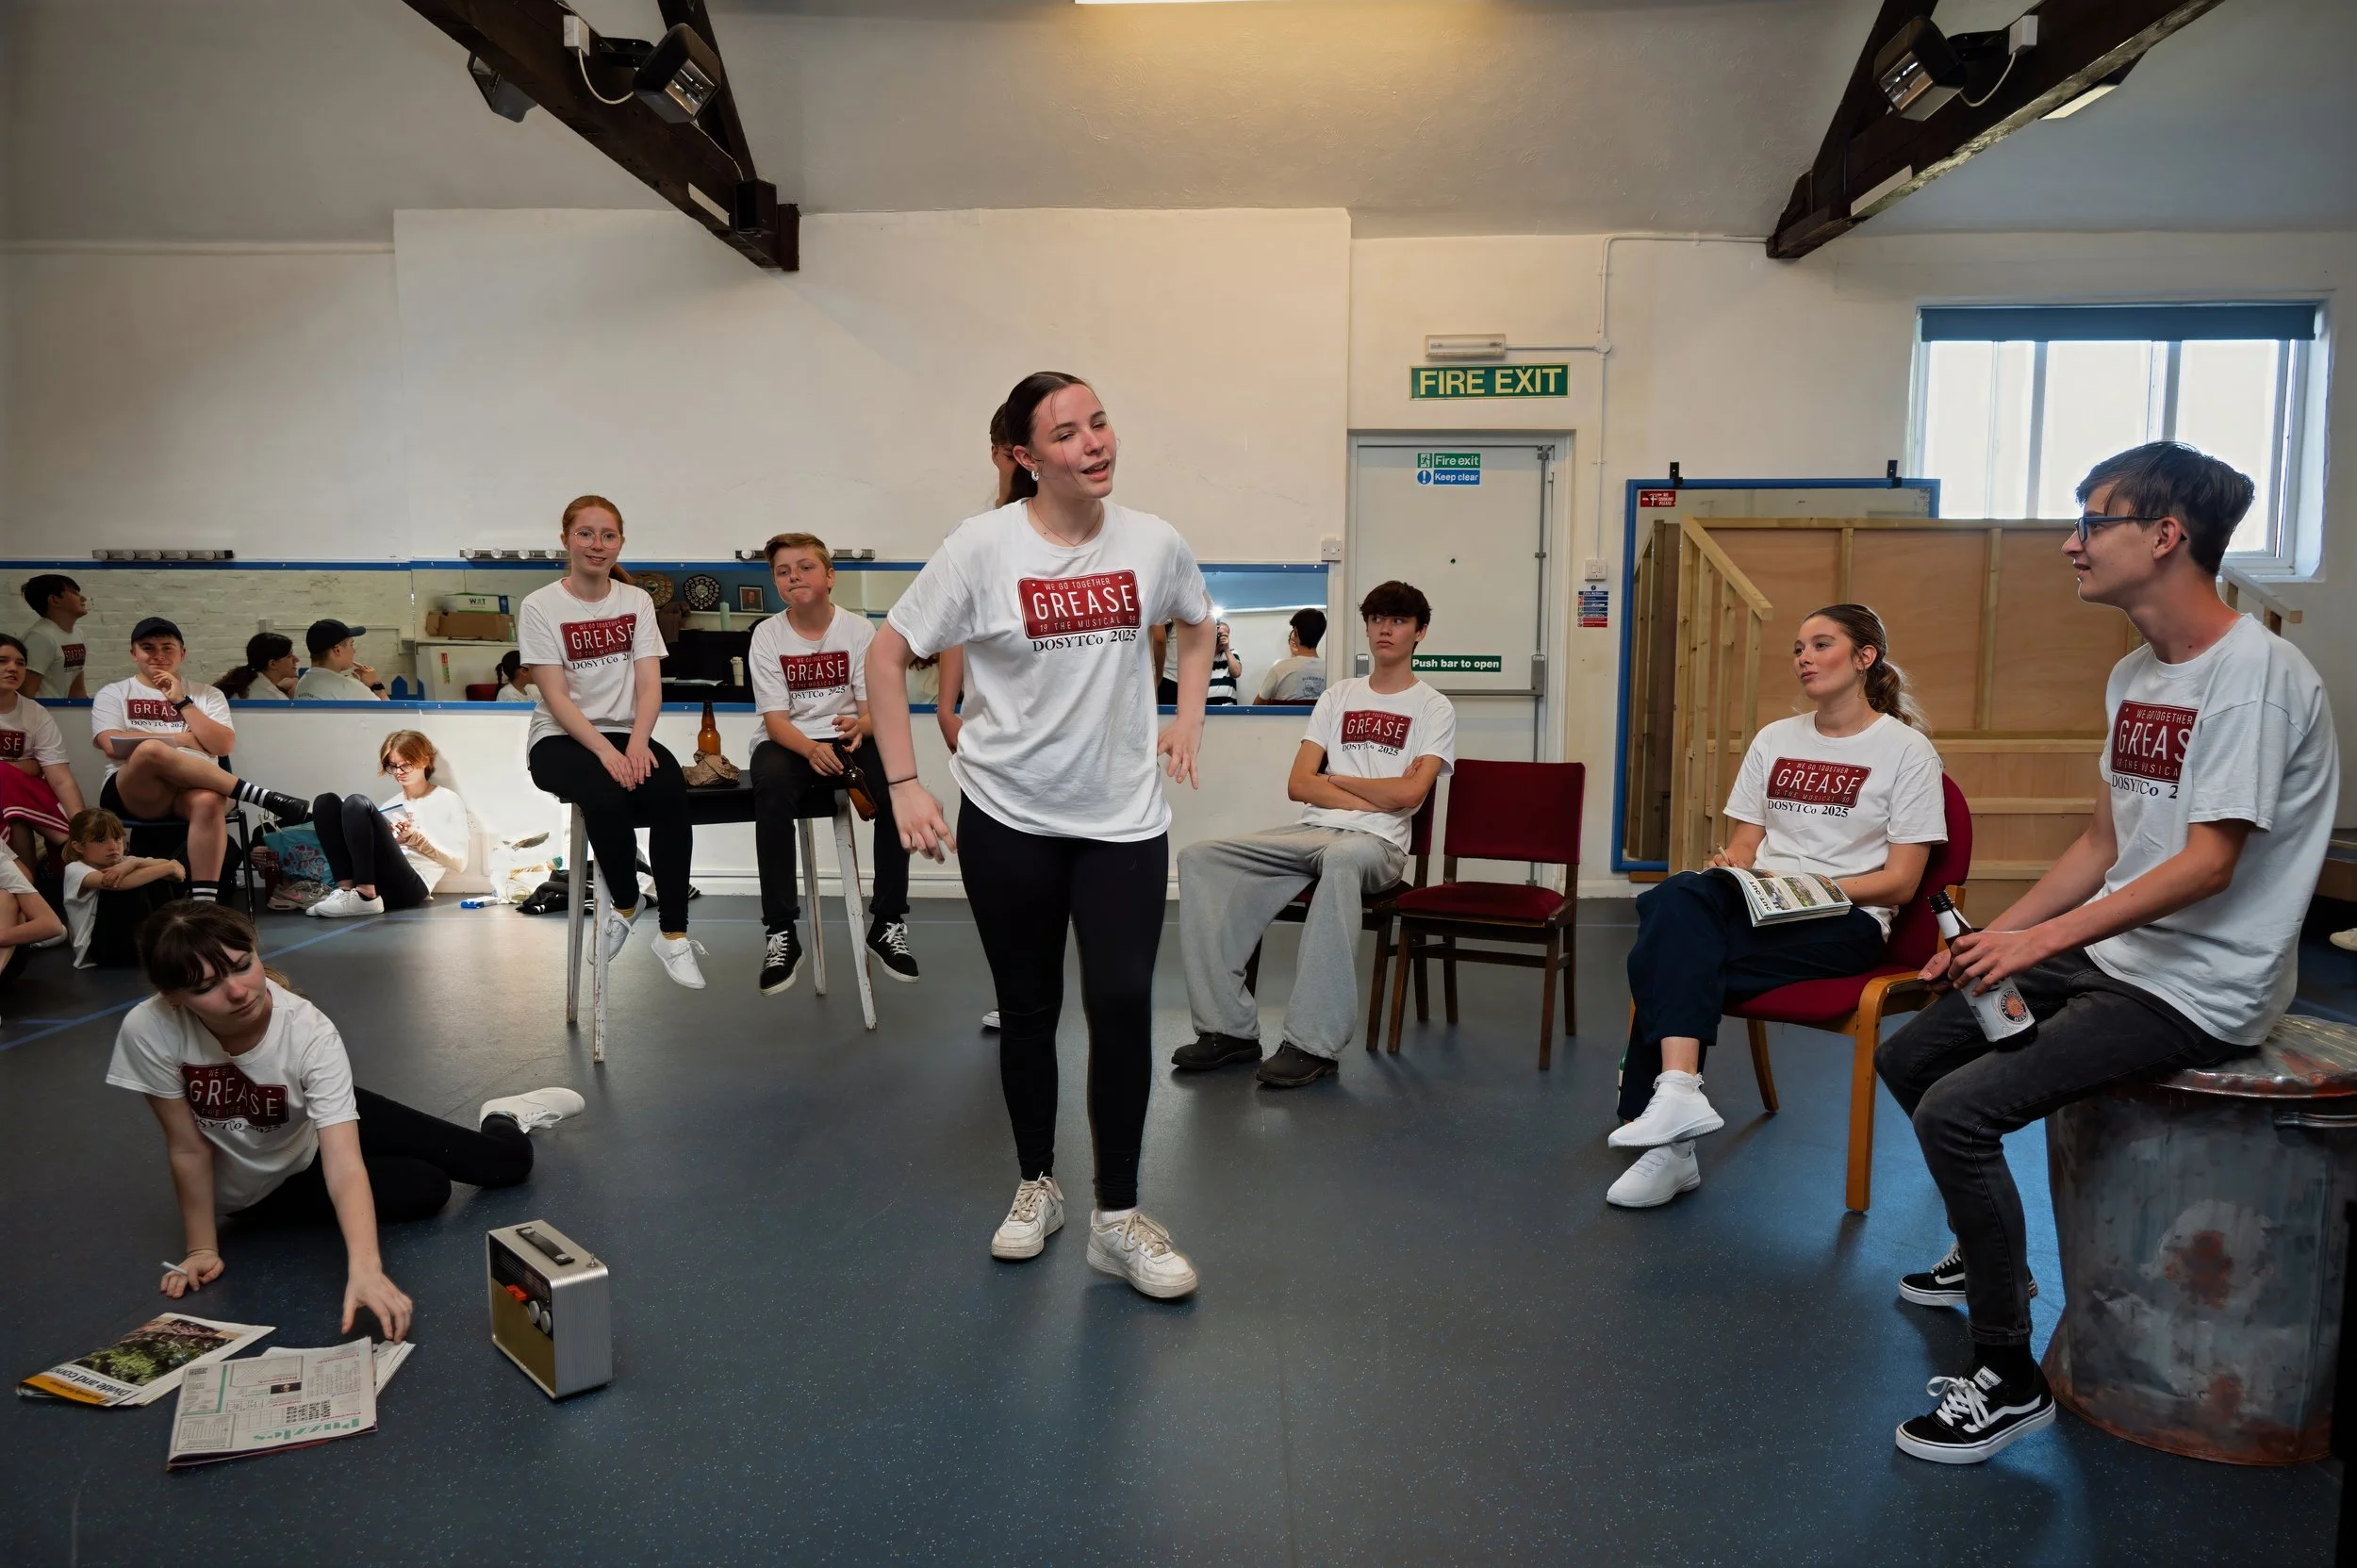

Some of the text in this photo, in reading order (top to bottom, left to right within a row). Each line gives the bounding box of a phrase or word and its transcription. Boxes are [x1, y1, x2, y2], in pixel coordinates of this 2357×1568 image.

[1419, 368, 1562, 395] FIRE EXIT
[1435, 455, 1479, 466] Fire exit
[1434, 473, 1479, 484] Keep clear
[1044, 577, 1111, 591] WE GO TOGETHER
[1032, 585, 1135, 620] GREASE
[1054, 621, 1072, 631] THE
[1078, 616, 1121, 628] MUSICAL
[1032, 629, 1137, 652] DOSYTCo 2025
[571, 656, 618, 670] DOSYTCo
[1411, 658, 1500, 670] Push bar to open
[786, 659, 845, 682] GREASE
[1346, 717, 1405, 739] GREASE
[1377, 745, 1399, 756] 2025
[1818, 765, 1849, 774] TOGETHER
[1776, 768, 1861, 795] GREASE
[1802, 793, 1836, 802] MUSICAL
[1768, 800, 1849, 818] DOSYTCo 2025
[190, 1077, 279, 1117] GREASE
[73, 1376, 97, 1388] and
